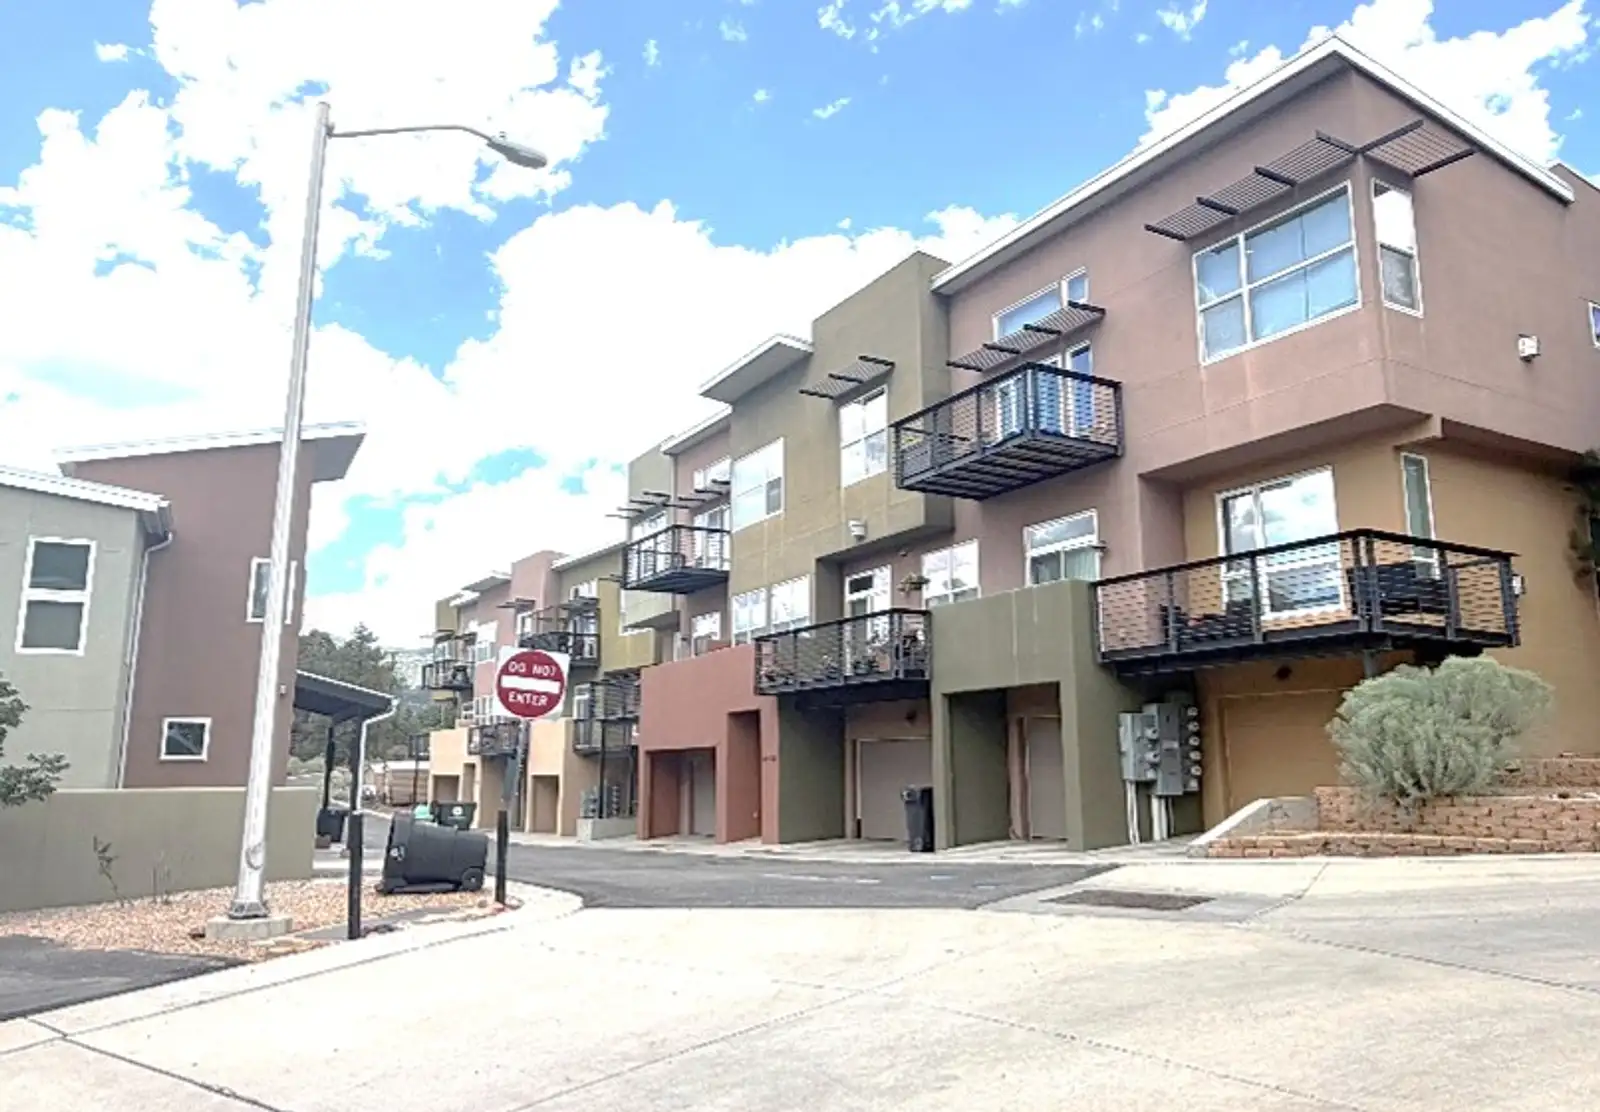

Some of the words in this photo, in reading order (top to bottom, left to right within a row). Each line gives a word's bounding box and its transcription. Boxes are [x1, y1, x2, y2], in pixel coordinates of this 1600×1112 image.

[508, 661, 527, 673] DO
[532, 664, 557, 676] NOT
[508, 691, 548, 706] ENTER
